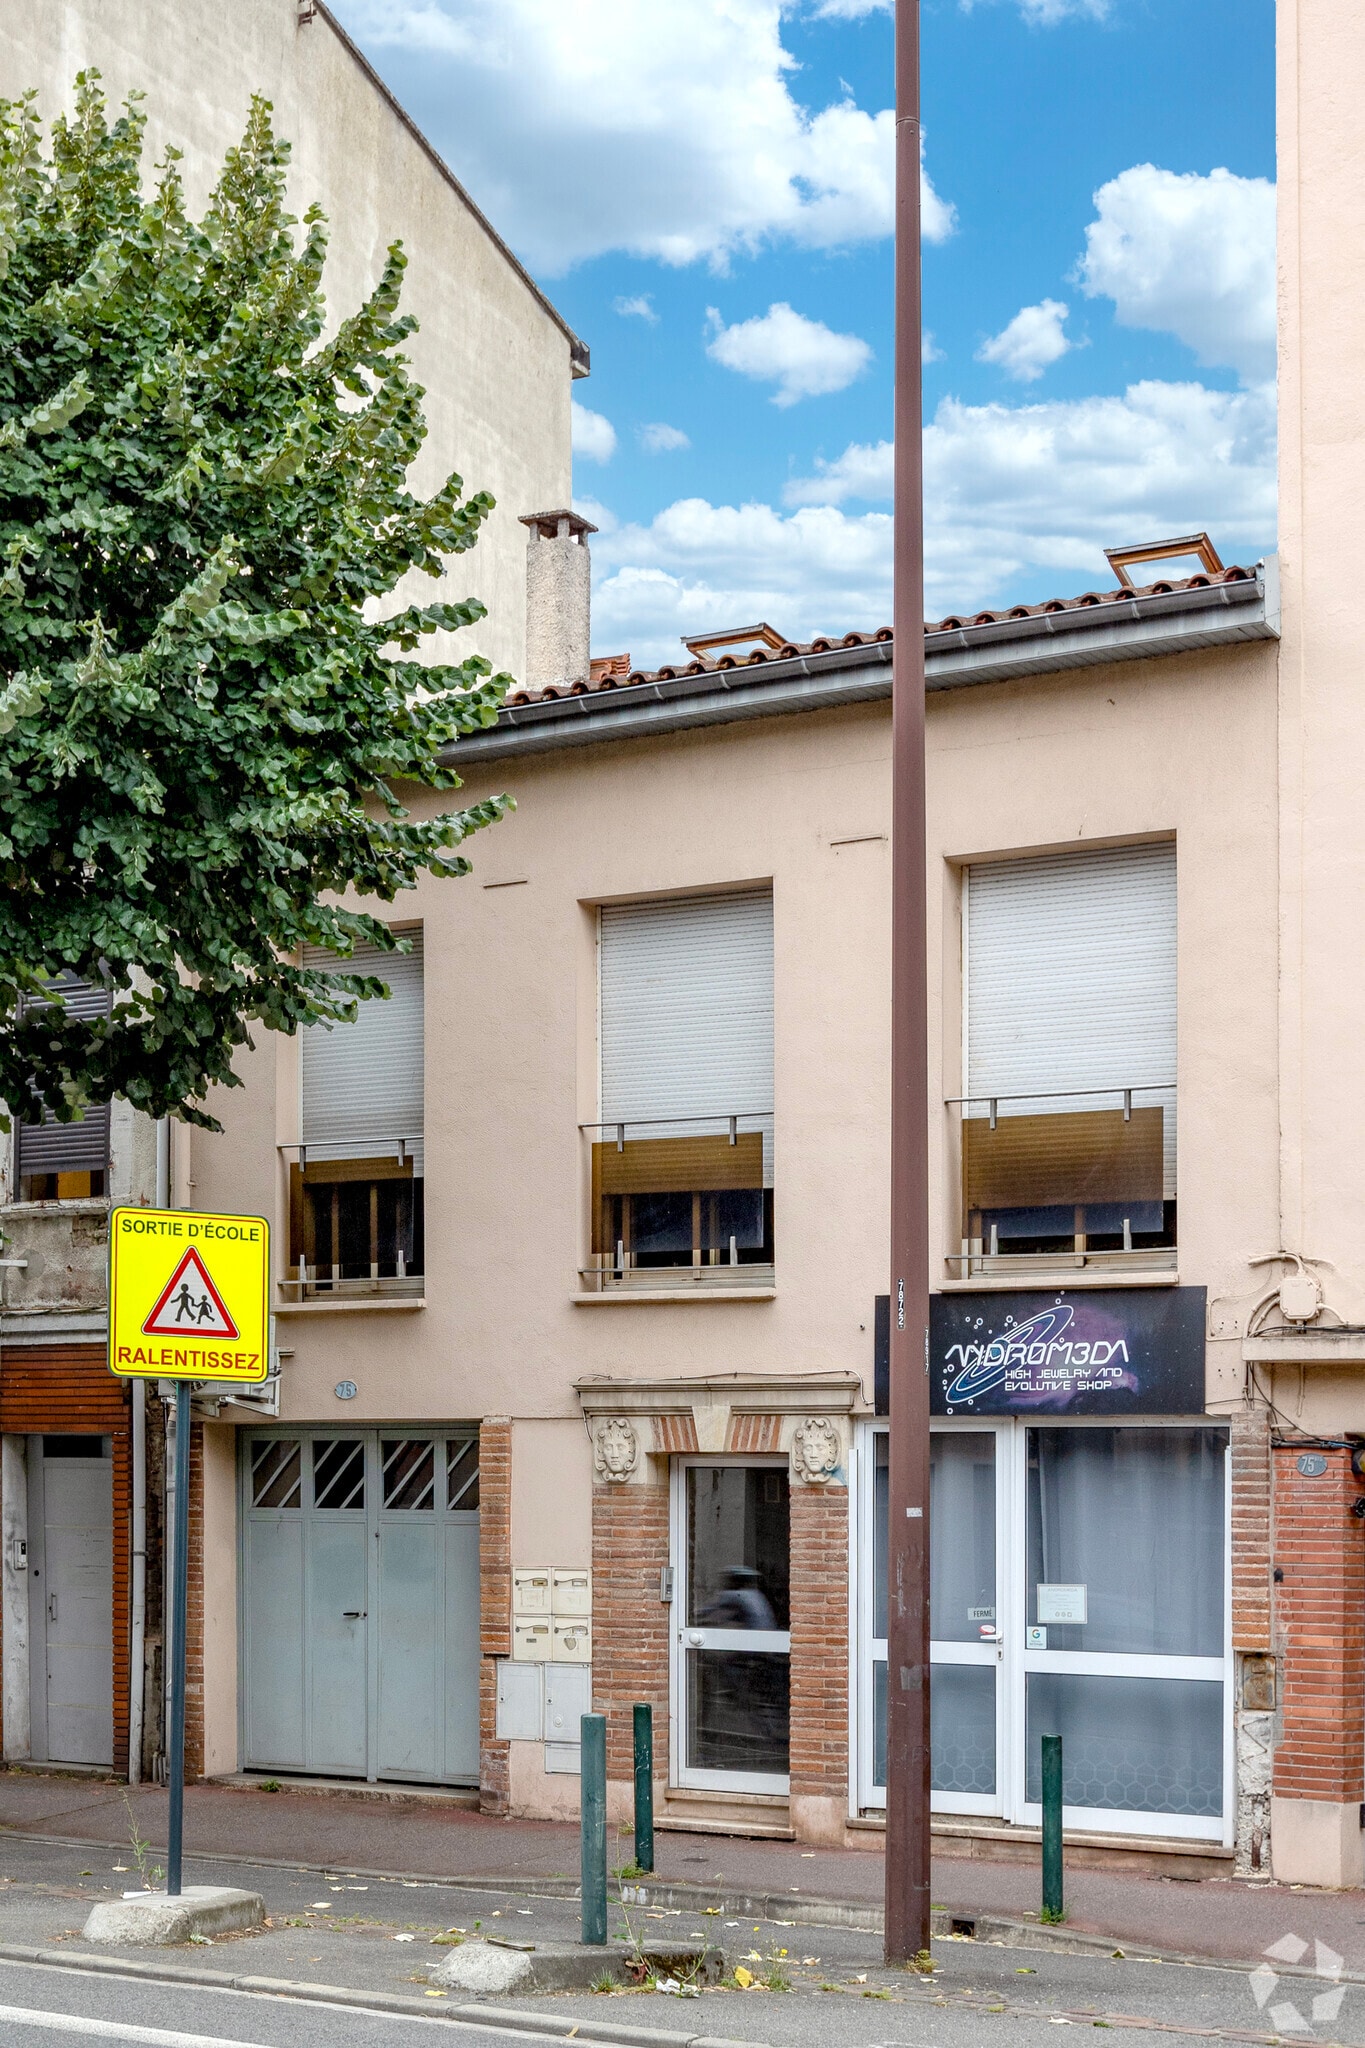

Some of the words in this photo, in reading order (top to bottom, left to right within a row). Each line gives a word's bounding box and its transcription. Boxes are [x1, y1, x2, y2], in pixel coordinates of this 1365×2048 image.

[122, 1219, 183, 1237] SORTIE
[188, 1222, 260, 1242] D'ÉCOLE
[118, 1346, 260, 1370] RALENTISSEZ
[1005, 1369, 1032, 1379] HIGH
[1036, 1368, 1091, 1379] JEWELRY
[1095, 1367, 1123, 1378] AND
[340, 1383, 352, 1397] 75
[1004, 1380, 1071, 1391] EVOLUTIVE
[1077, 1380, 1112, 1391] SHOP
[1301, 1456, 1315, 1473] 75
